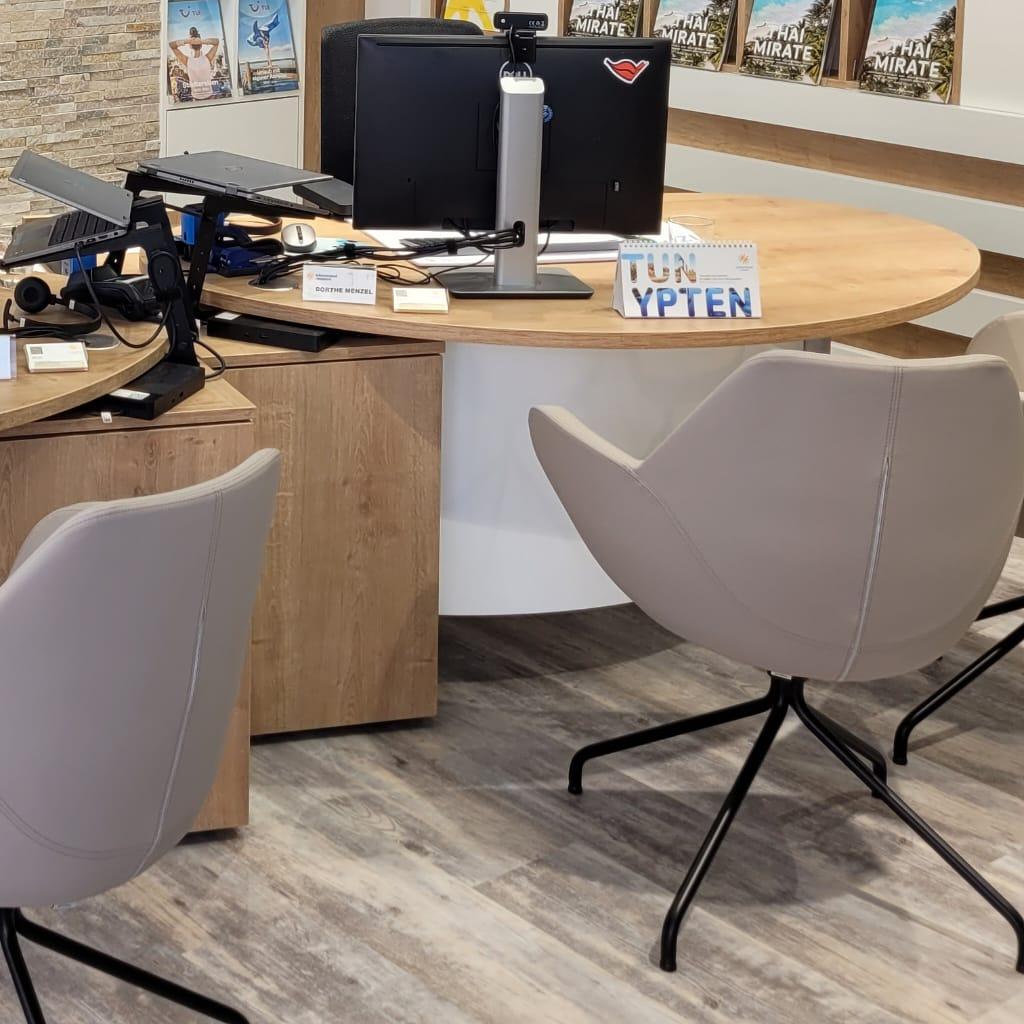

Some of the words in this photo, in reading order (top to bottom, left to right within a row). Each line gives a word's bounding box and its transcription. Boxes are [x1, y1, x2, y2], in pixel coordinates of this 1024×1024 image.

[575, 17, 627, 37] MIRATE
[662, 29, 717, 47] MIRATE
[753, 39, 814, 61] MIRATE
[875, 55, 941, 77] MIRATE
[621, 252, 696, 283] TUN
[631, 287, 752, 317] YPTEN
